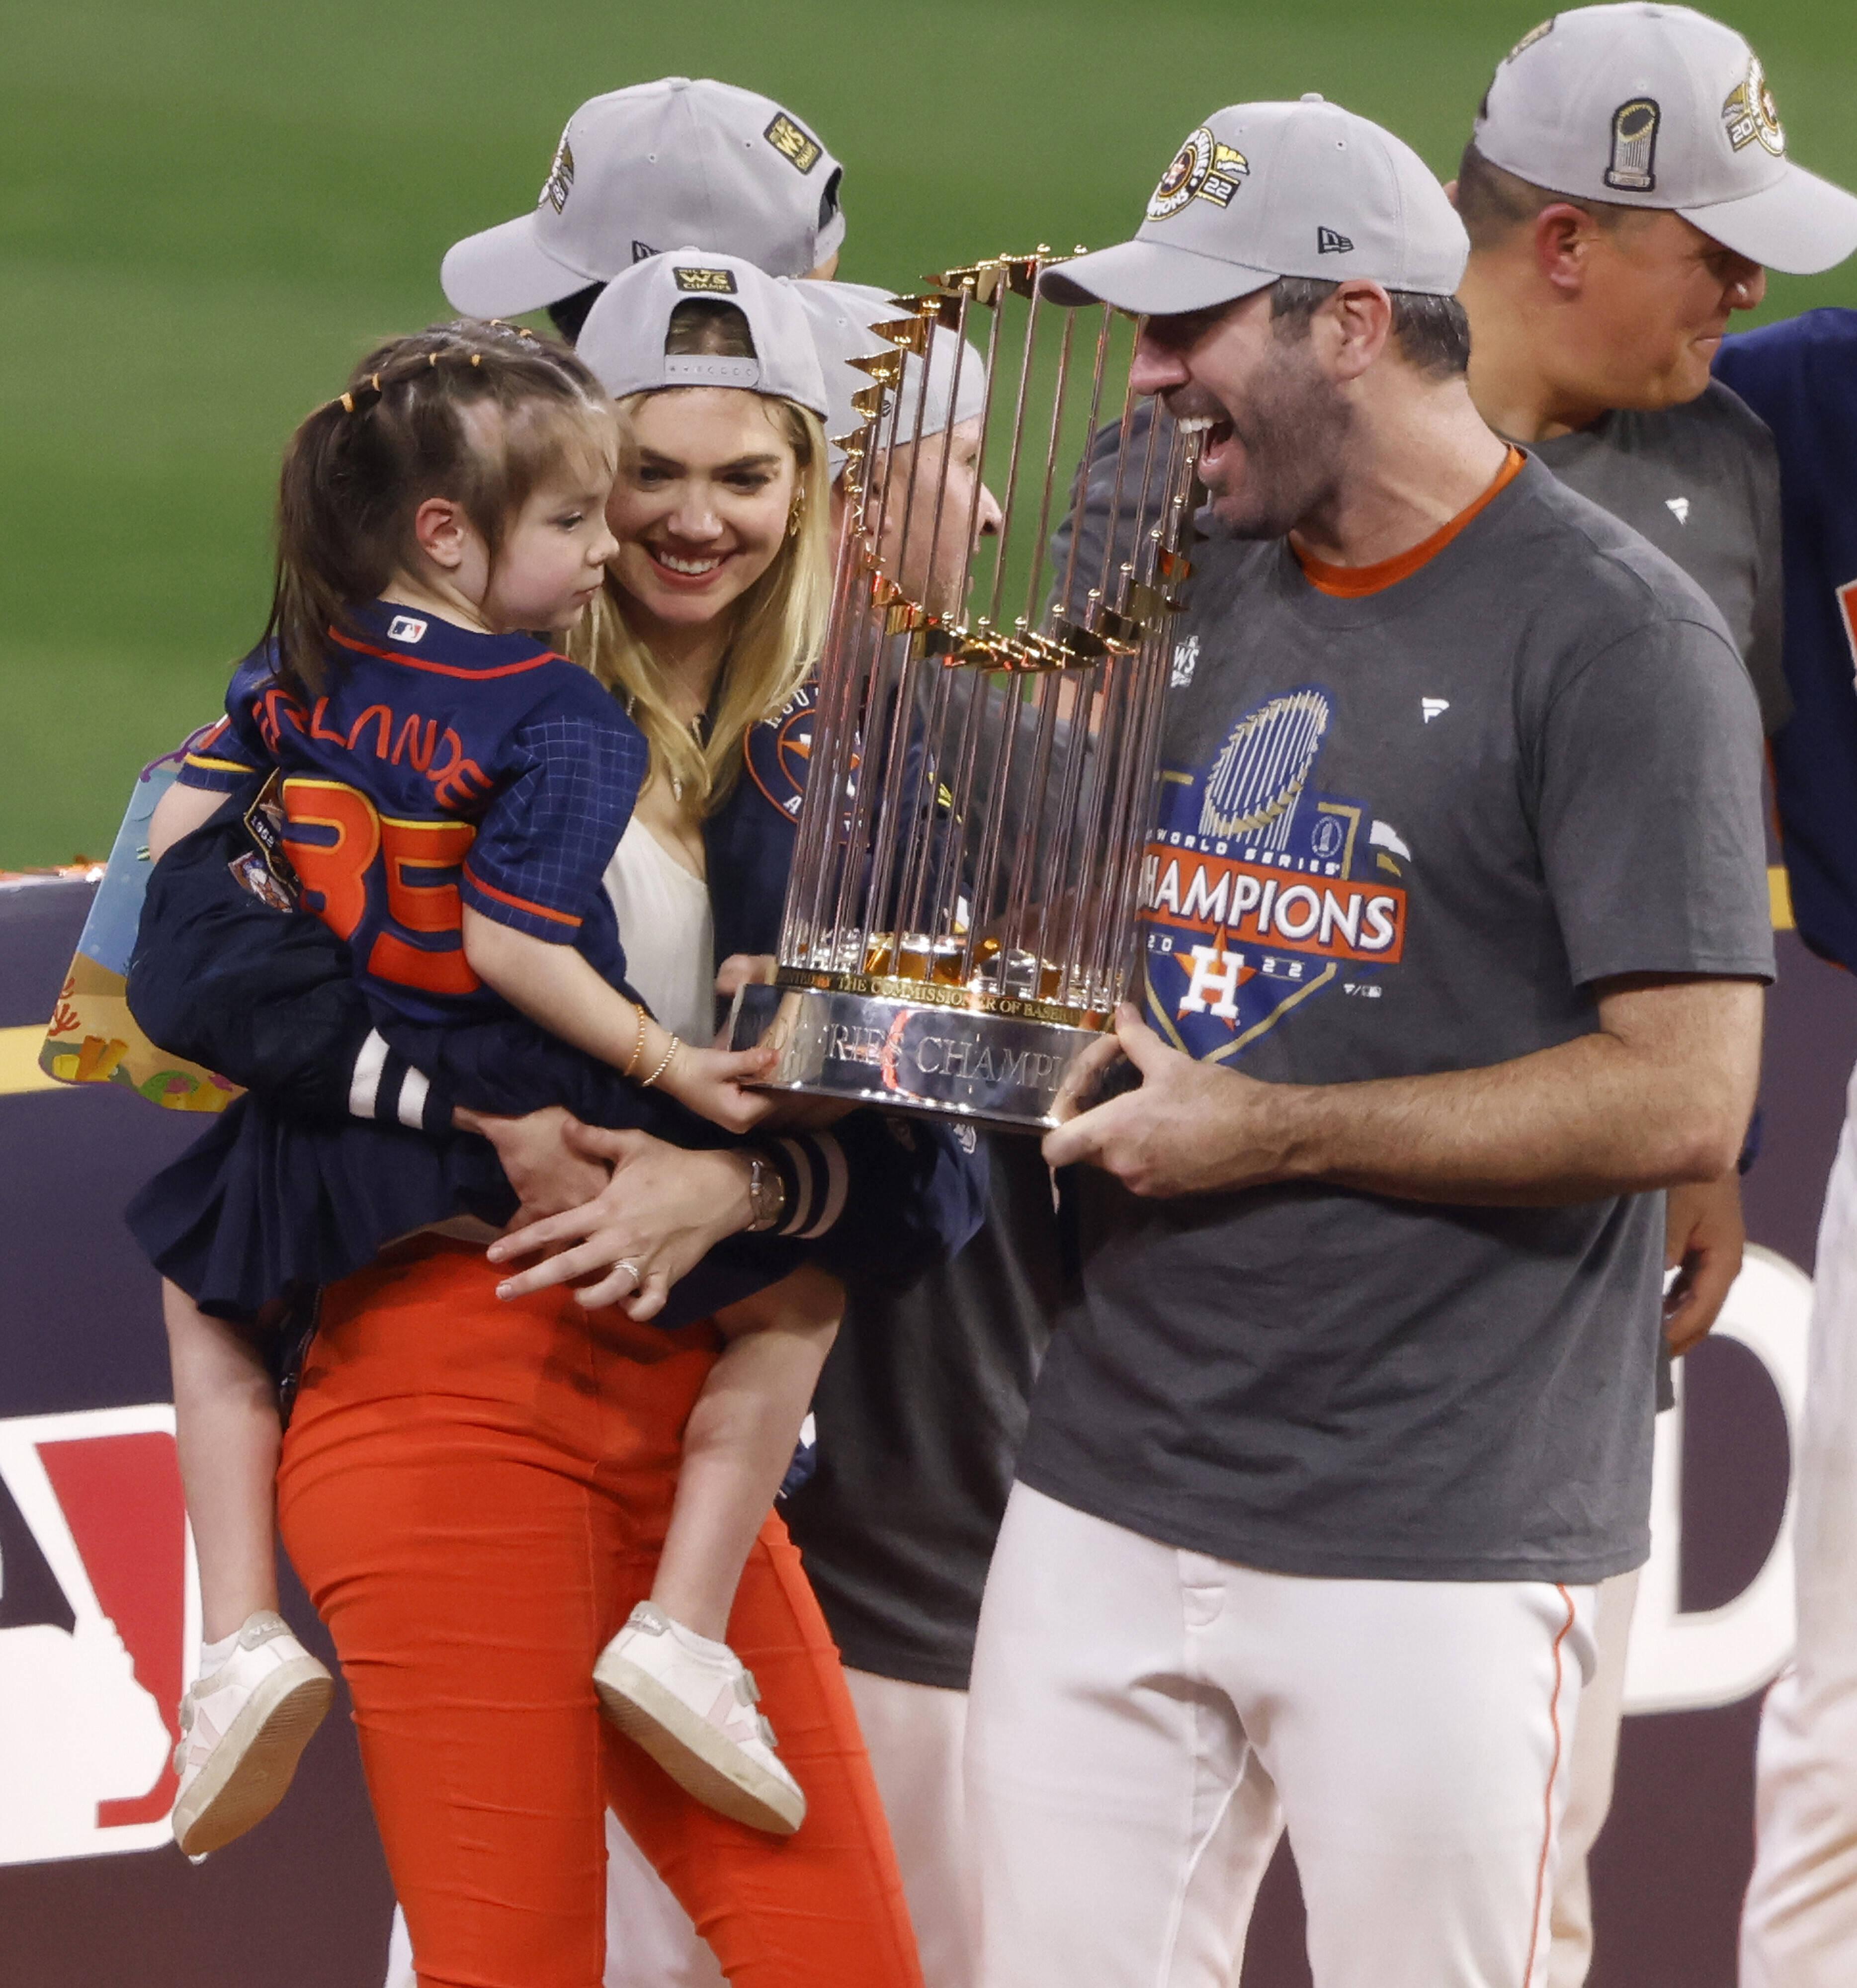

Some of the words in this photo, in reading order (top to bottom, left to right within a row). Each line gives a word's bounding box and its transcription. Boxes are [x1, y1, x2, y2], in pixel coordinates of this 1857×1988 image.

[776, 125, 804, 158] WS
[1731, 118, 1753, 143] 20
[1203, 176, 1232, 200] 22
[679, 273, 728, 284] WS
[1174, 646, 1199, 673] WS
[1157, 828, 1228, 855] WORLD
[1245, 848, 1337, 875] SERIES
[1141, 854, 1395, 949] HAMPIONS
[1148, 934, 1172, 951] 20
[1262, 958, 1302, 977] 22
[837, 975, 867, 992] THE
[999, 1001, 1020, 1014] OF
[1180, 945, 1244, 1019] H
[828, 1023, 904, 1067] RIES
[916, 1037, 1064, 1091] CHAMPI
